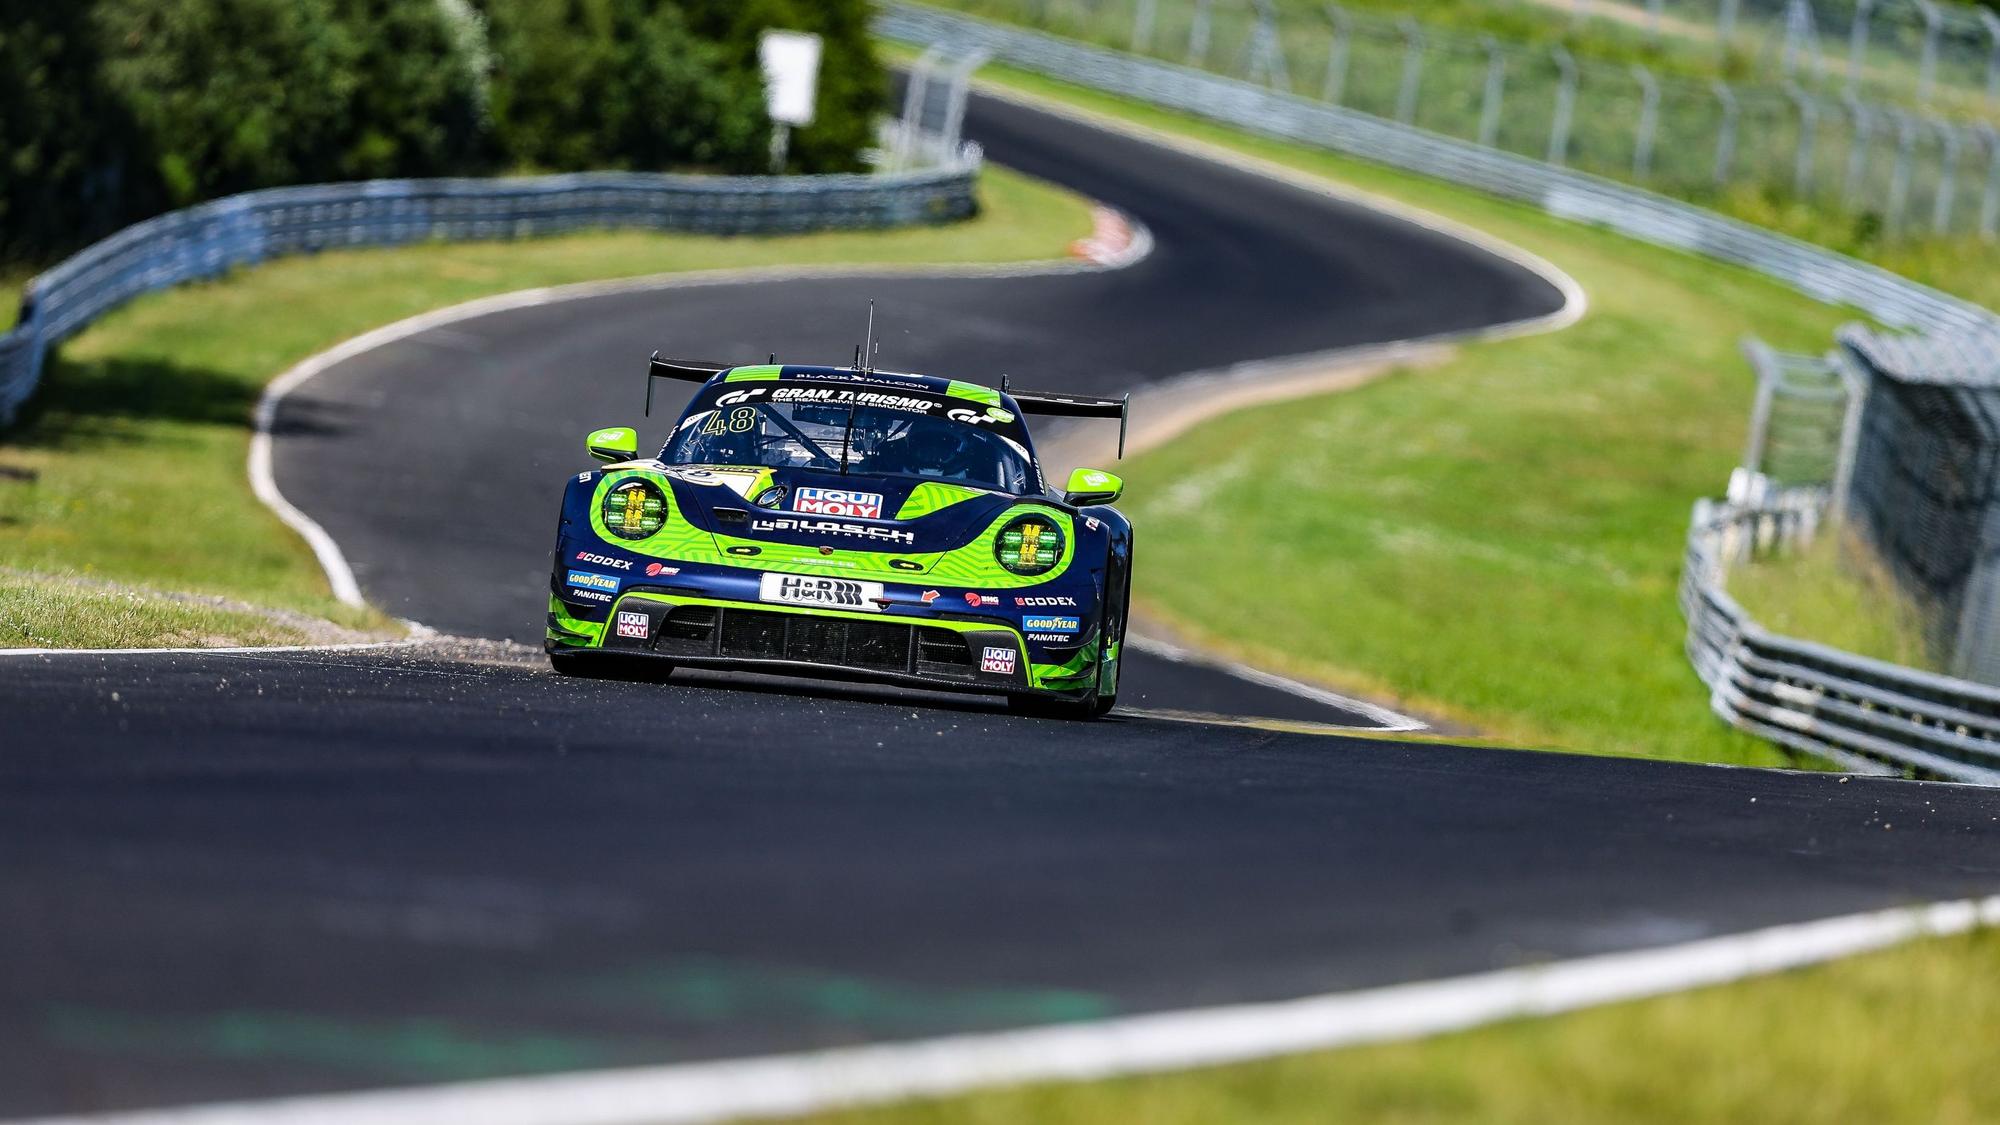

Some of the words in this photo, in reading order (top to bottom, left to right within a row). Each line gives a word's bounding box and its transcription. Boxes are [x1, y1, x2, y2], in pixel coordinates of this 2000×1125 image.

[865, 378, 929, 389] FALCON
[771, 387, 835, 399] GRAN
[867, 402, 928, 415] SIMULATOR
[702, 406, 756, 436] 48
[800, 488, 881, 505] LIQUI
[799, 501, 880, 519] MOLY
[798, 528, 914, 545] LUXEMBOURG
[583, 553, 633, 570] CODEX
[569, 574, 617, 589] GOODYEAR
[573, 589, 613, 602] FANATEC
[1024, 596, 1077, 607] CODEX
[620, 613, 647, 626] LIQUI
[1026, 617, 1078, 631] GOODYEAR
[618, 625, 648, 638] MOLY
[1027, 633, 1070, 642] FANATEC
[985, 649, 1014, 661] LIQUI
[983, 659, 1013, 672] MOLY
